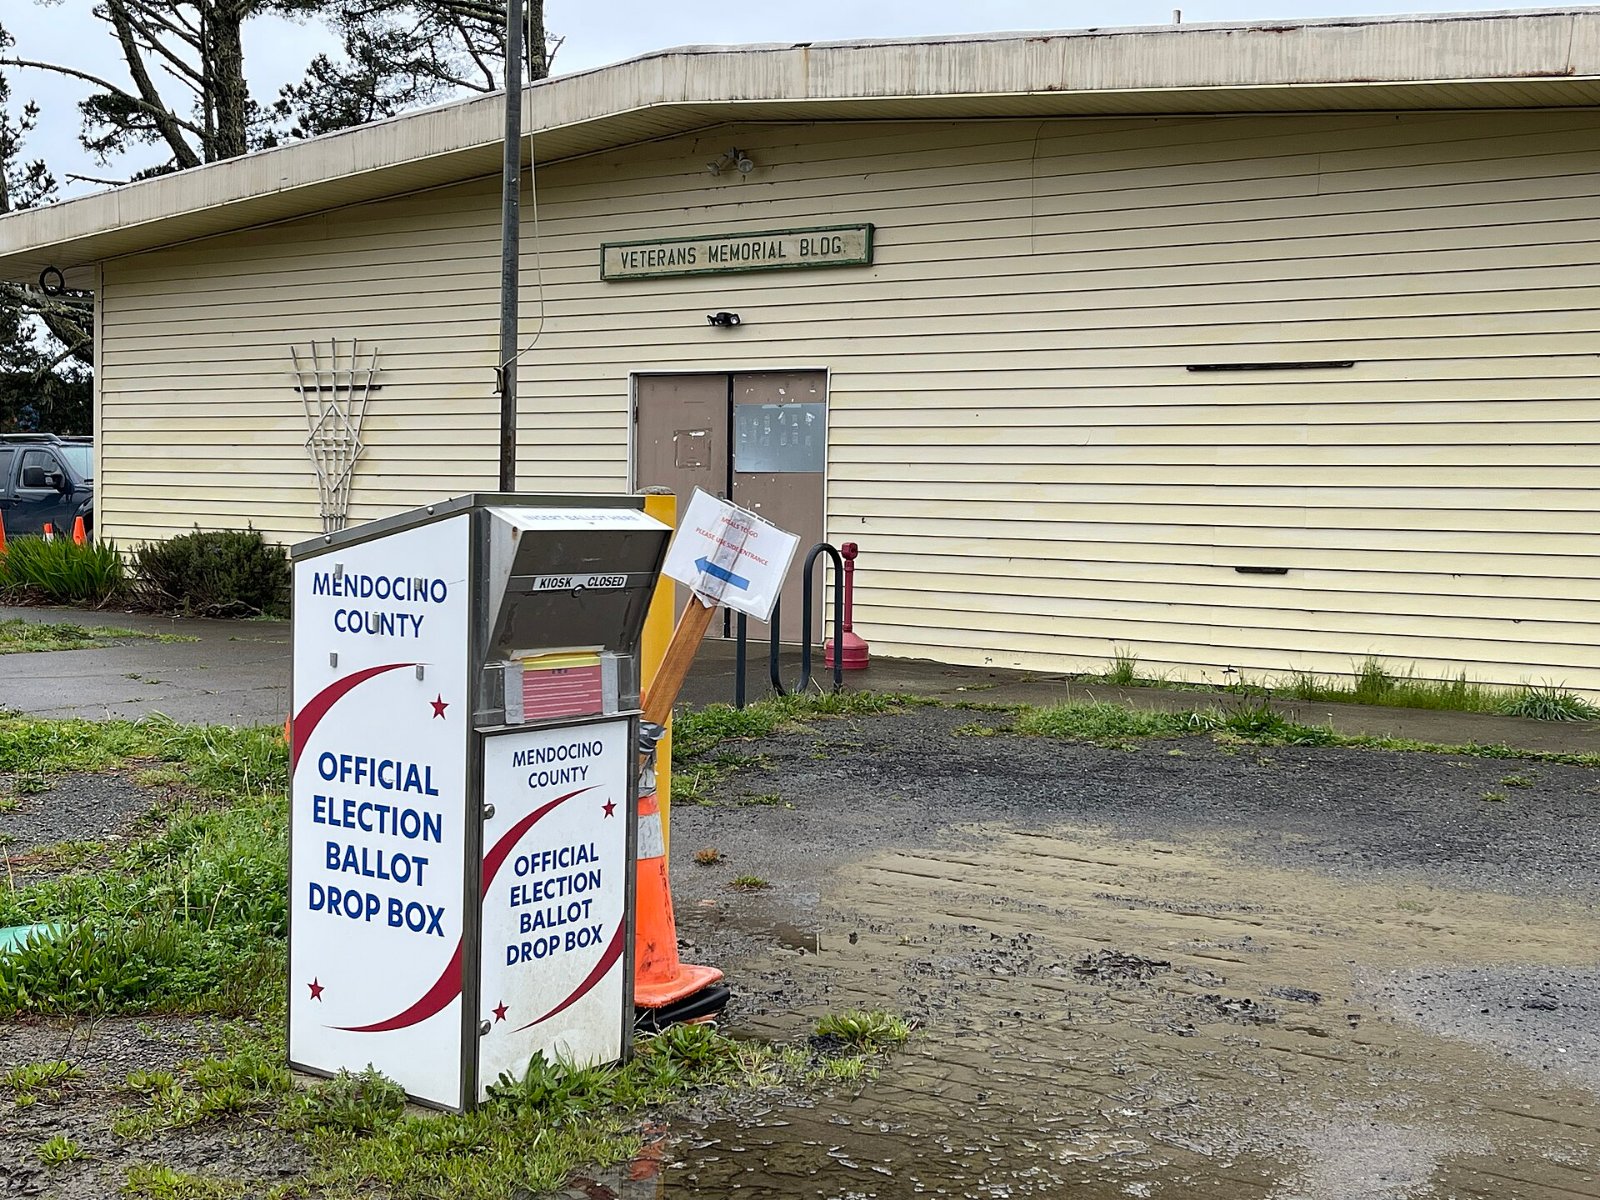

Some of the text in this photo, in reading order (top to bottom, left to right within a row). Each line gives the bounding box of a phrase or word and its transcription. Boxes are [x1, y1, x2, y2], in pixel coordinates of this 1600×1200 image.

[621, 236, 847, 269] VETERANS MEMORIAL BLDG.
[695, 527, 716, 541] PLEASE
[726, 543, 740, 552] SIDE
[739, 548, 769, 566] ENTRANCE
[312, 572, 447, 603] MENDOCINO
[539, 576, 625, 589] KIOSK CLOSED
[334, 609, 424, 638] COUNTY
[512, 740, 603, 768] MENDOCINO
[318, 751, 439, 797] OFFICIAL
[528, 765, 589, 789] COUNTY
[313, 794, 442, 843] ELECTION
[326, 841, 429, 886] BALLOT
[514, 842, 599, 877] OFFICIAL
[510, 869, 602, 908] ELECTION
[309, 882, 446, 937] DROP BOX
[519, 899, 593, 934] BALLOT
[506, 923, 604, 966] DROP BOX
